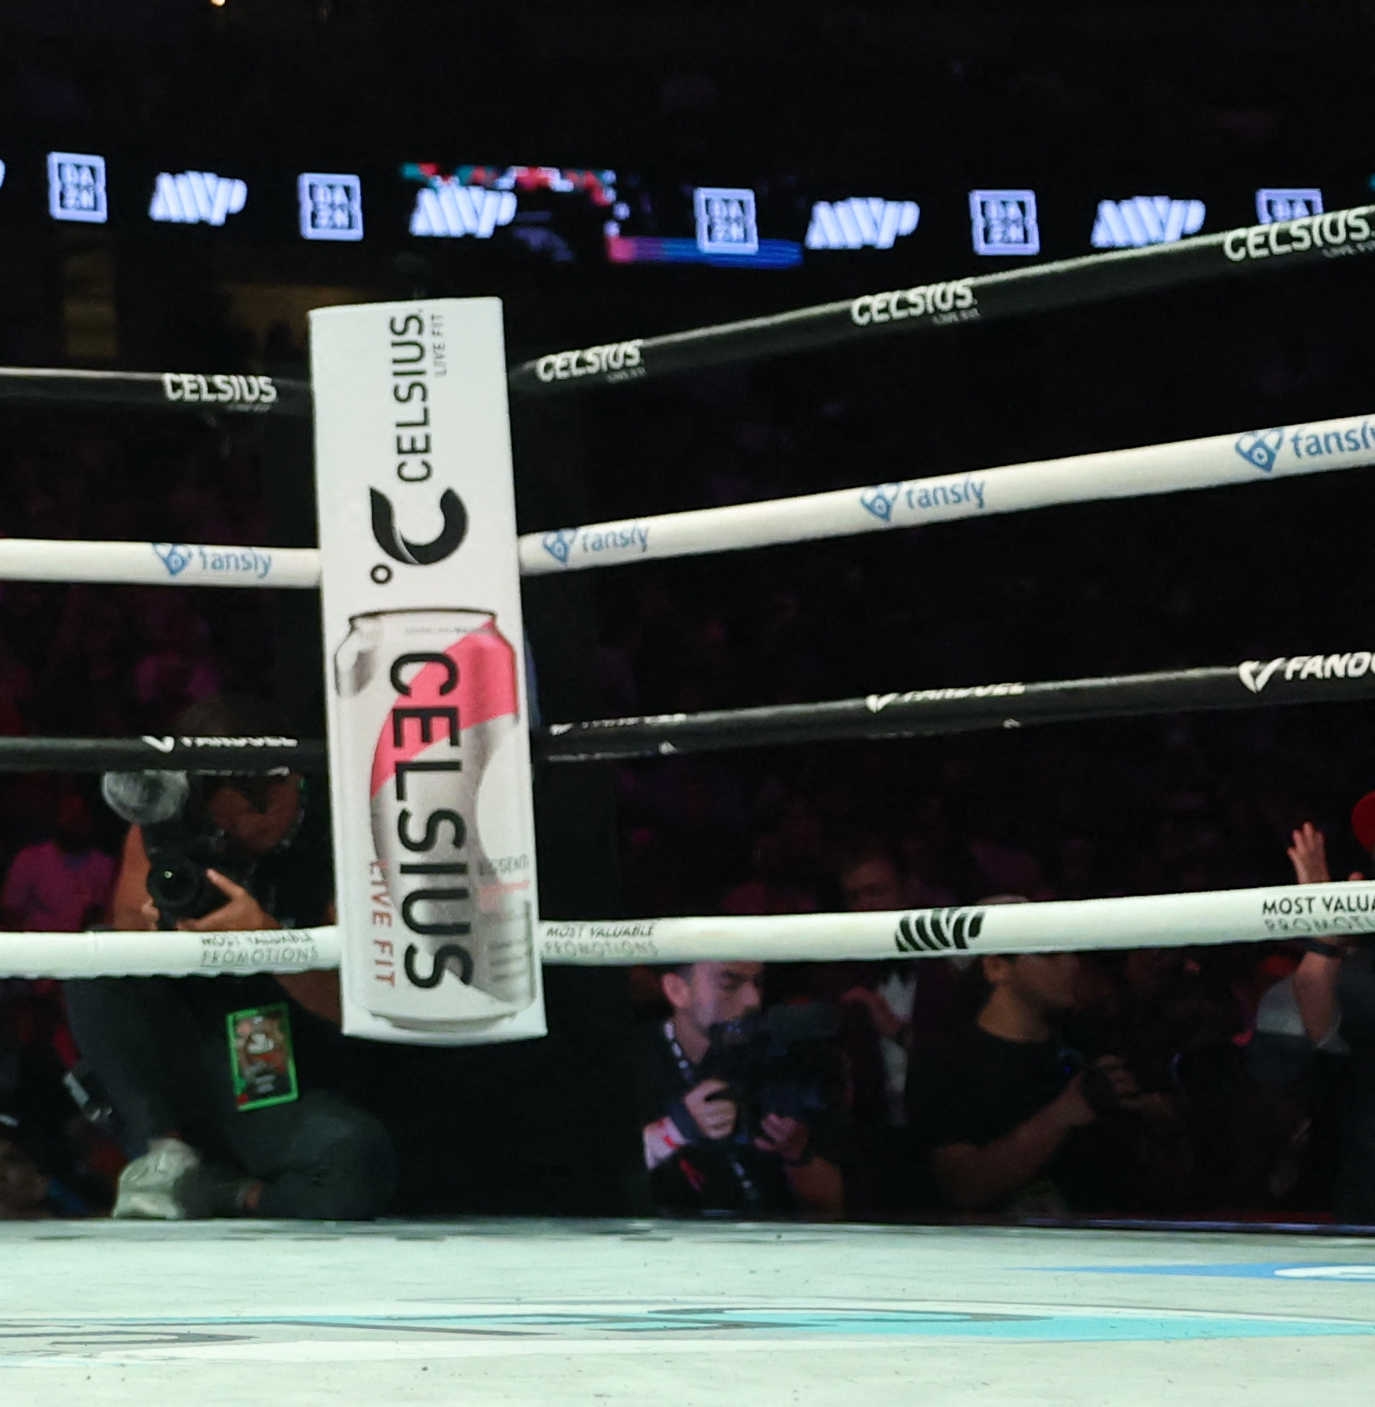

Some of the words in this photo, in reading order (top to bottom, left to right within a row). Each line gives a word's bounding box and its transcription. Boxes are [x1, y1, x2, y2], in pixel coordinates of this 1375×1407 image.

[1224, 206, 1371, 262] CELSIUS
[852, 278, 977, 326] CELSIUS
[536, 340, 644, 382] CELSIUS
[163, 372, 277, 403] CELSIUS
[390, 314, 432, 483] CELSIUS
[906, 478, 987, 510] fansly
[1284, 652, 1375, 680] FAND
[390, 651, 474, 990] CELSIUS
[369, 861, 393, 928] LIVE
[1262, 897, 1315, 915] MOST
[373, 939, 396, 987] FIT
